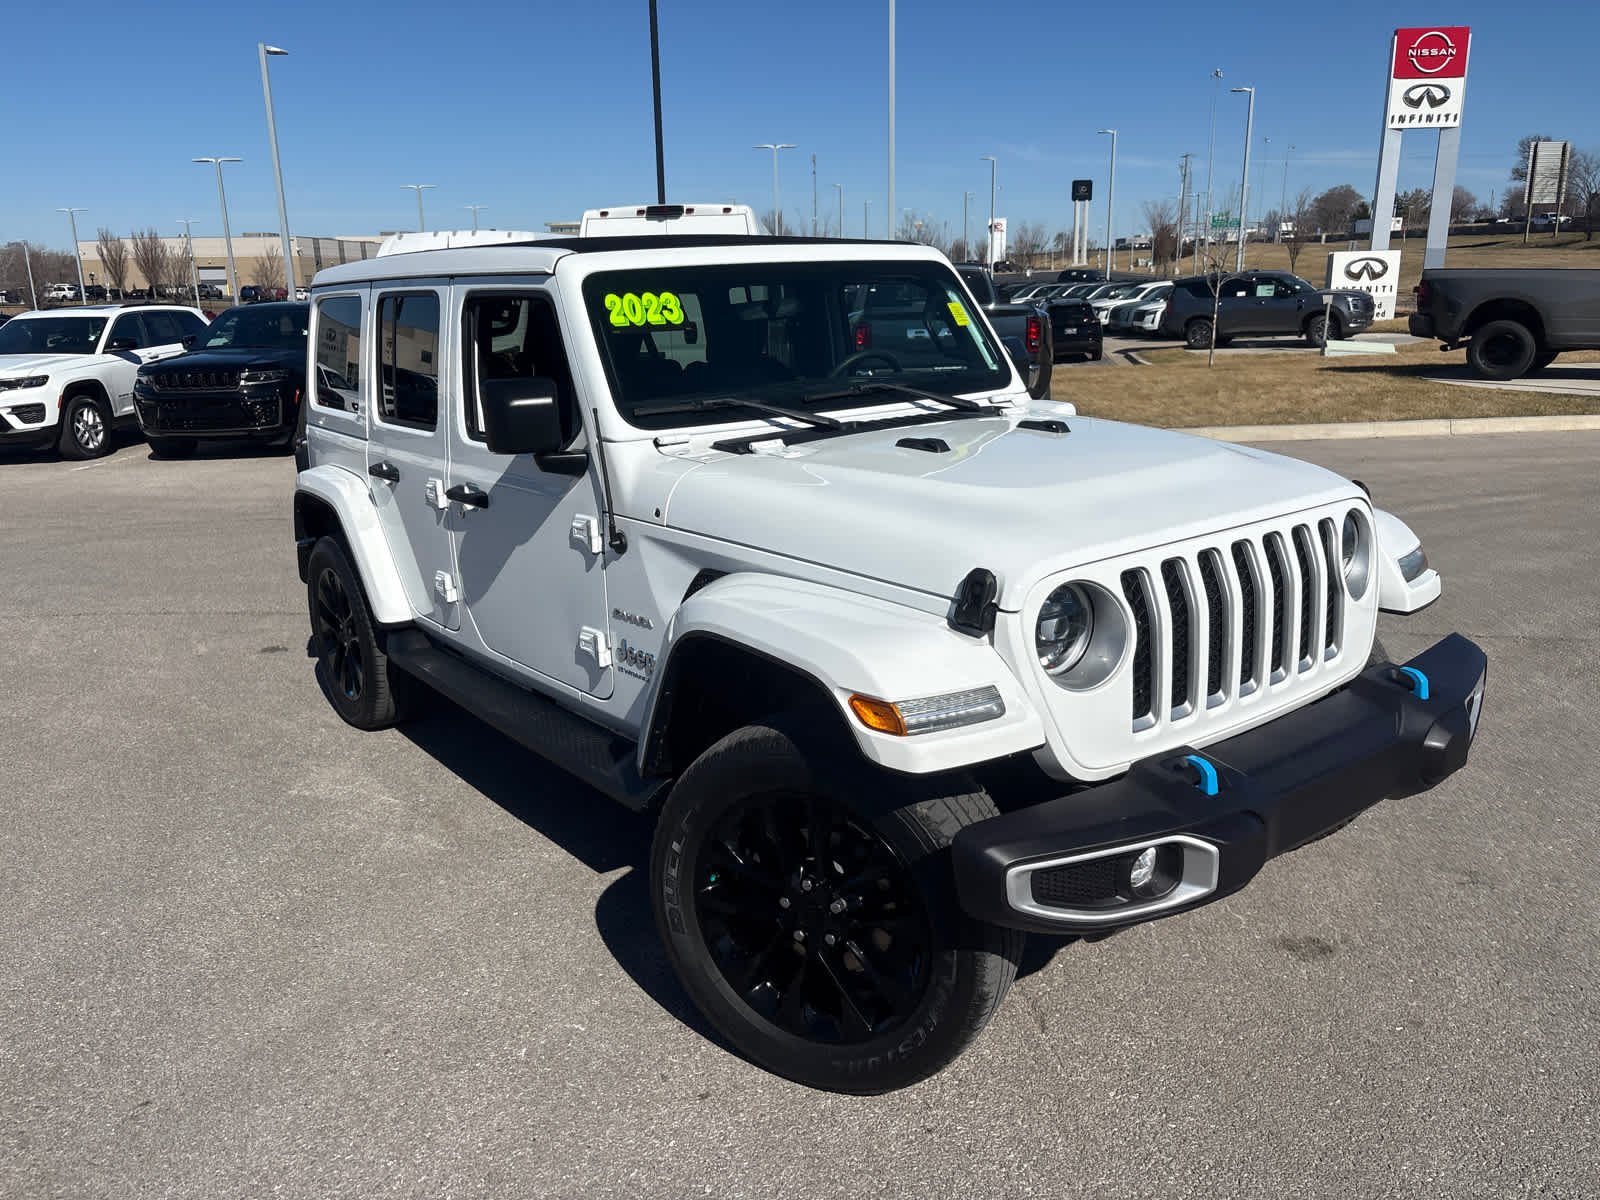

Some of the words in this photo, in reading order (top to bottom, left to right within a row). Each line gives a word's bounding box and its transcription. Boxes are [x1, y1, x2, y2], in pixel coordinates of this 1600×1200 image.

[1408, 48, 1457, 56] NISSAN
[1390, 112, 1458, 125] INFINITI
[604, 291, 684, 327] 2023
